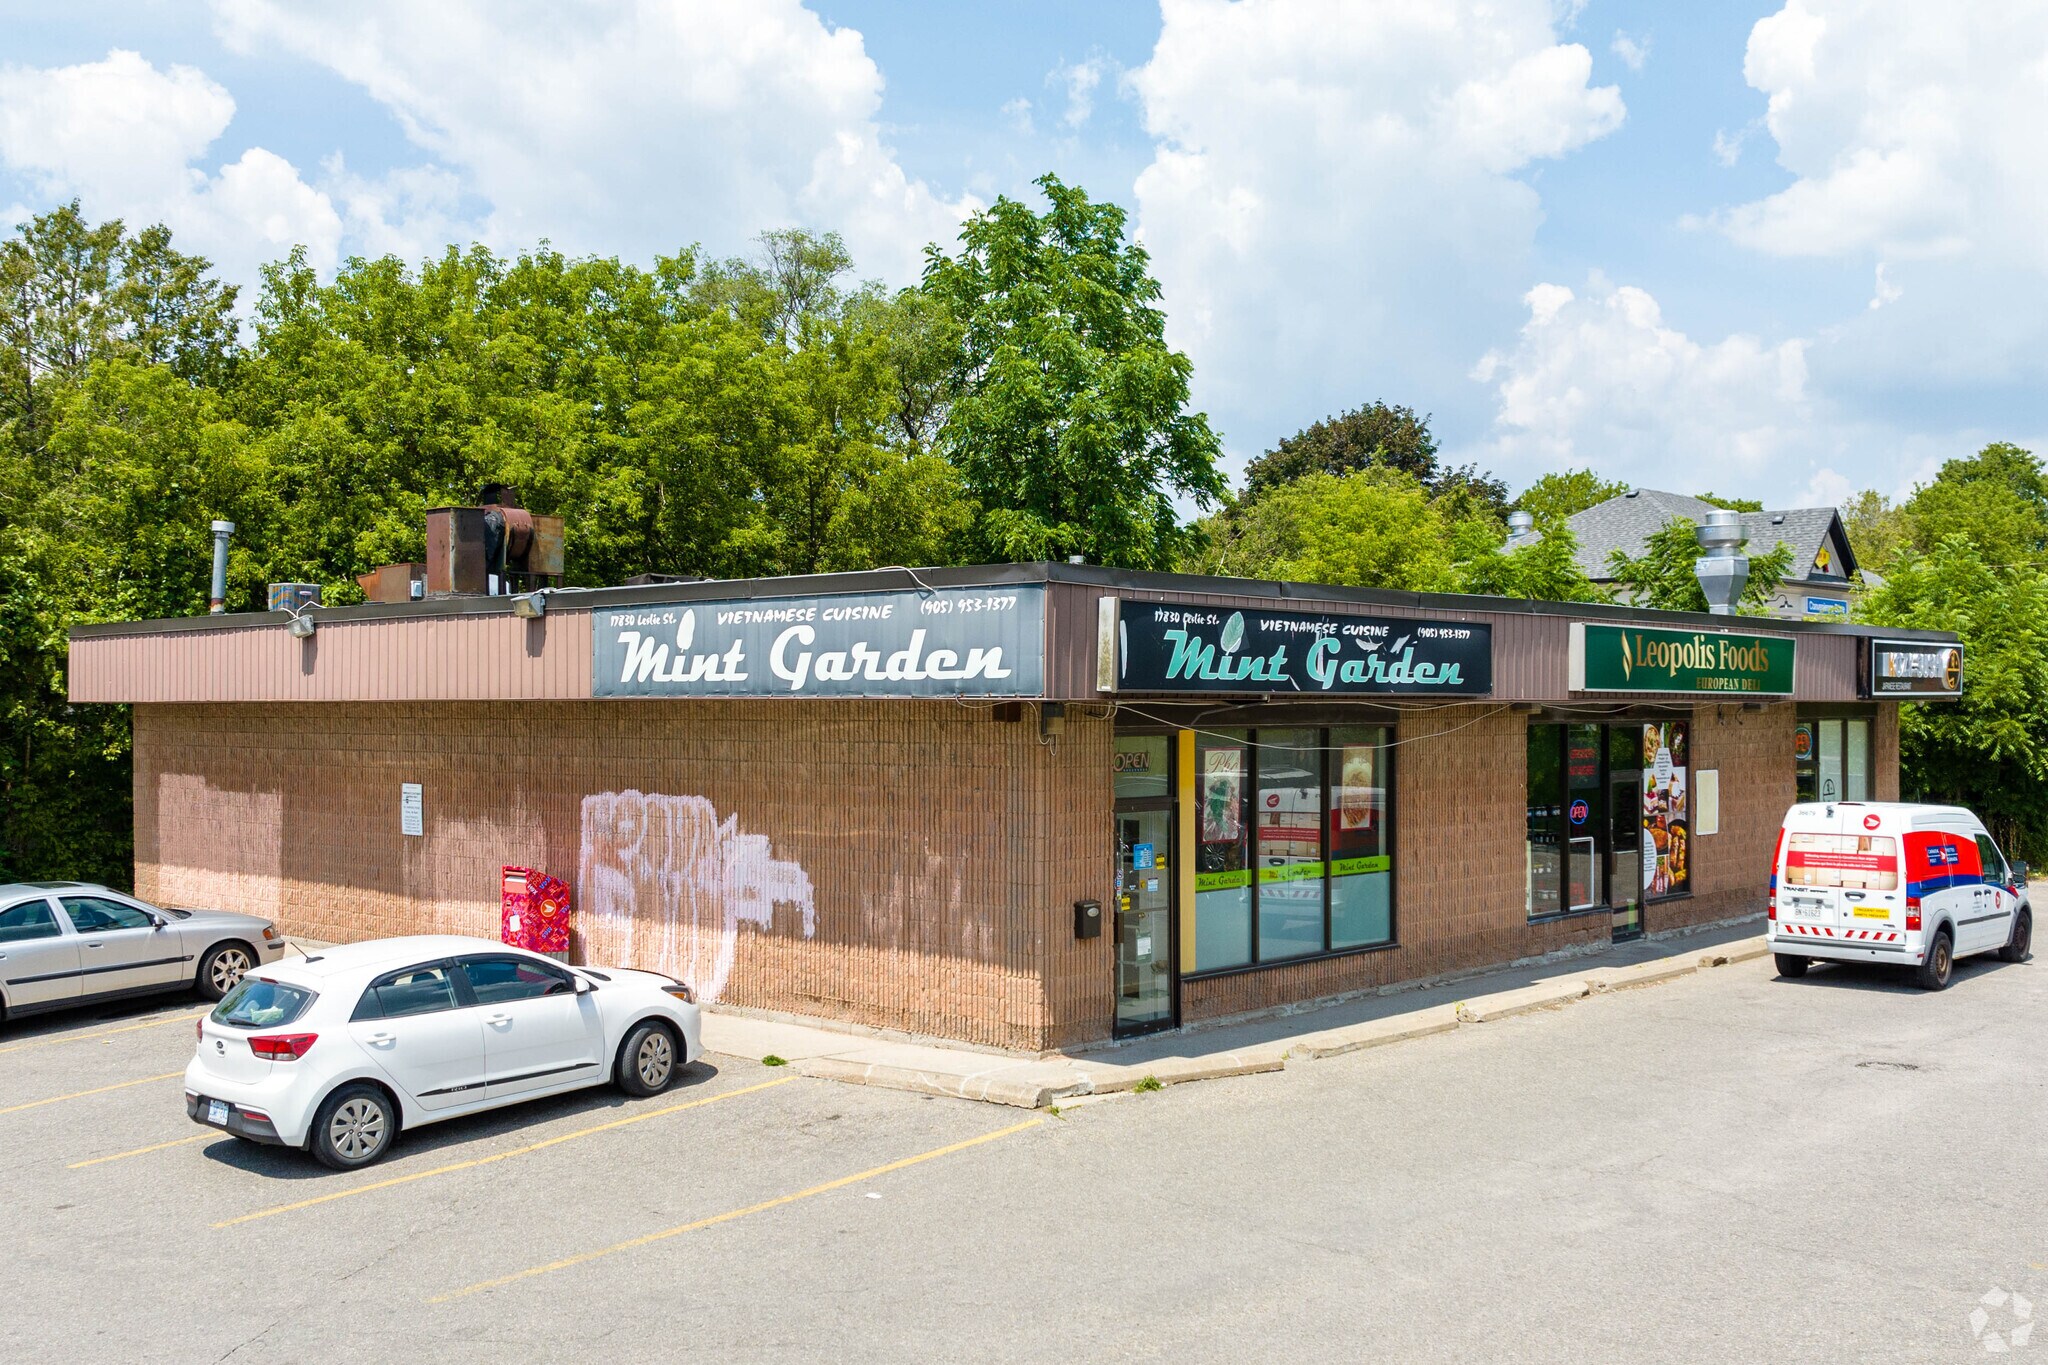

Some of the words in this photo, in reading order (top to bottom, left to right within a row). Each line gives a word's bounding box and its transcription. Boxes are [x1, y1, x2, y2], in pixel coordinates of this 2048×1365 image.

[717, 607, 817, 626] VIETNAMESE
[822, 604, 893, 621] CUISINE
[920, 599, 953, 616] (905)
[957, 596, 1017, 615] 953-1377
[610, 614, 636, 627] 17830
[637, 613, 661, 626] Leslie
[662, 612, 677, 625] St.
[1154, 609, 1180, 622] 17830
[1183, 612, 1205, 625] Leslie
[1206, 613, 1220, 625] St.
[1260, 619, 1338, 634] VIETNAMESE
[1342, 624, 1389, 637] CUISINE
[1417, 626, 1438, 638] (905)
[617, 630, 749, 683] Mint
[769, 624, 1012, 691] Garden
[1163, 629, 1289, 682] Mint
[1306, 637, 1464, 690] Garden
[1635, 634, 1716, 678] Leopolis
[1718, 639, 1769, 672] Foods
[1696, 677, 1740, 690] EUROPEAN
[1741, 678, 1761, 691] DELI
[1113, 753, 1150, 771] OPEN
[1571, 806, 1587, 818] OPEN
